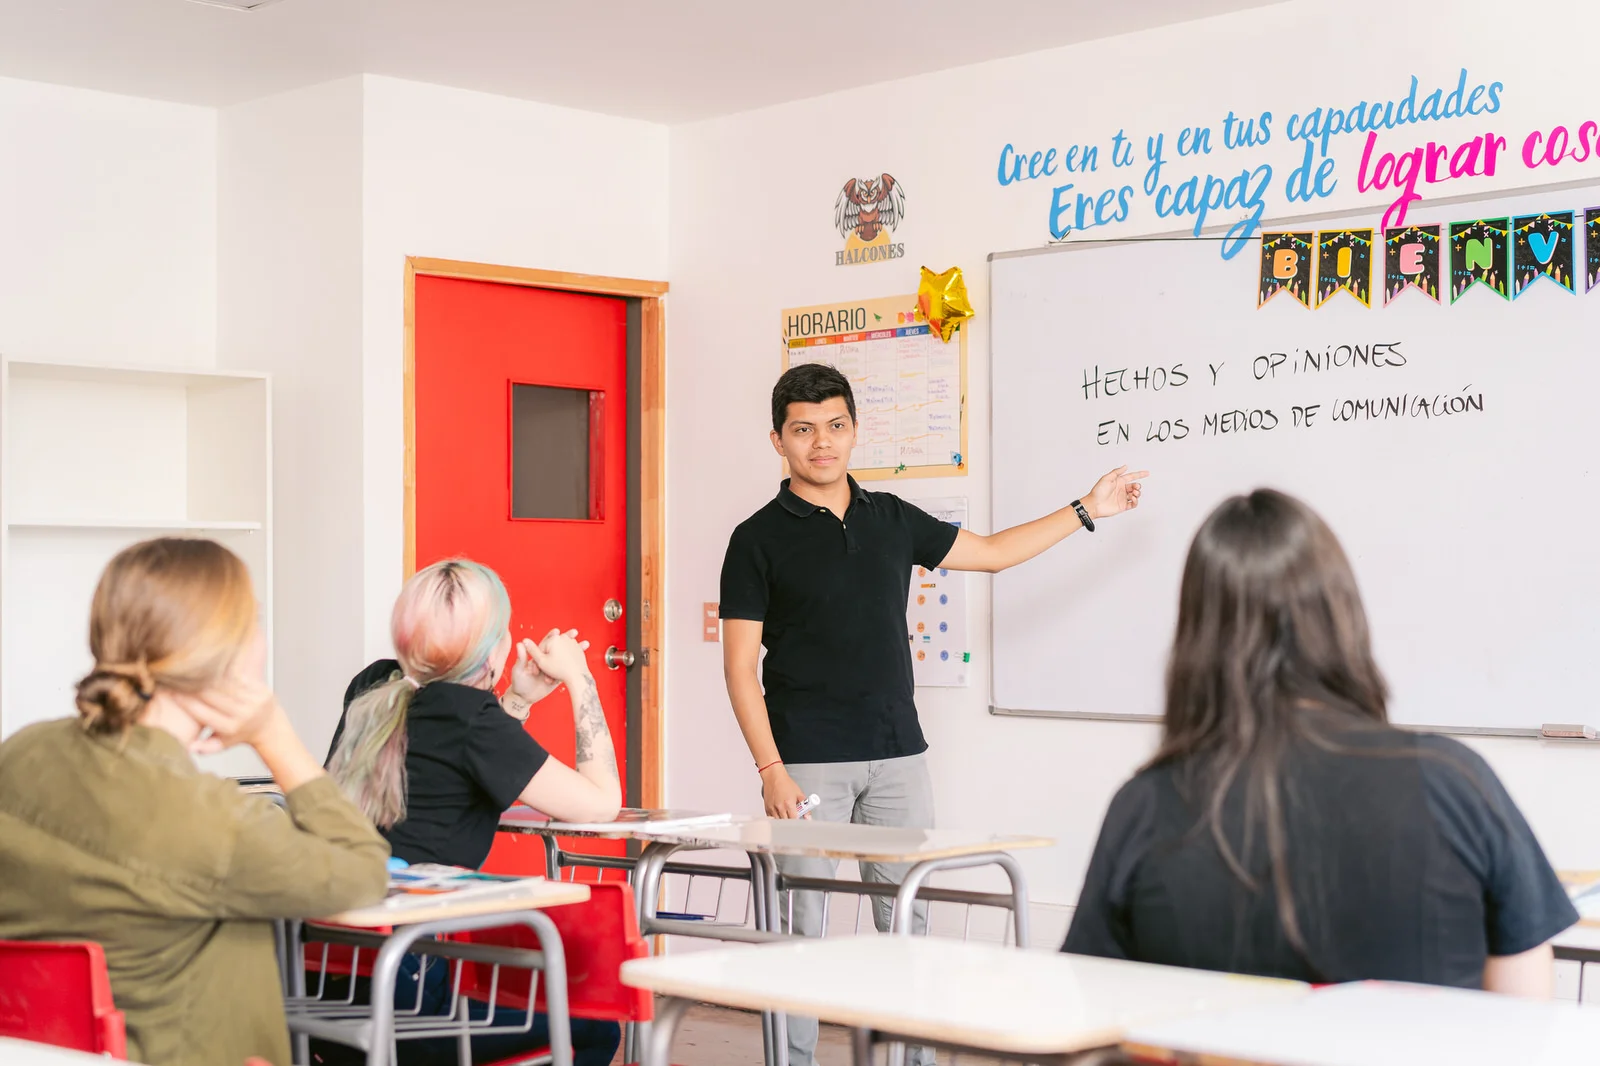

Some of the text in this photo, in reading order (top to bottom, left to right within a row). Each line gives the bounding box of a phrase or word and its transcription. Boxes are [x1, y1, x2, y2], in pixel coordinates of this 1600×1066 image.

[997, 67, 1504, 196] Cree en ti y en tus capacidades
[1049, 120, 1600, 261] Eres capaz de lograr cos
[835, 242, 905, 266] HALCONES
[788, 307, 866, 337] HORARIO
[1081, 364, 1189, 400] HECHOS
[1208, 361, 1225, 386] Y
[1096, 419, 1130, 445] EN
[1146, 418, 1190, 442] LOS
[1291, 404, 1321, 428] DE
